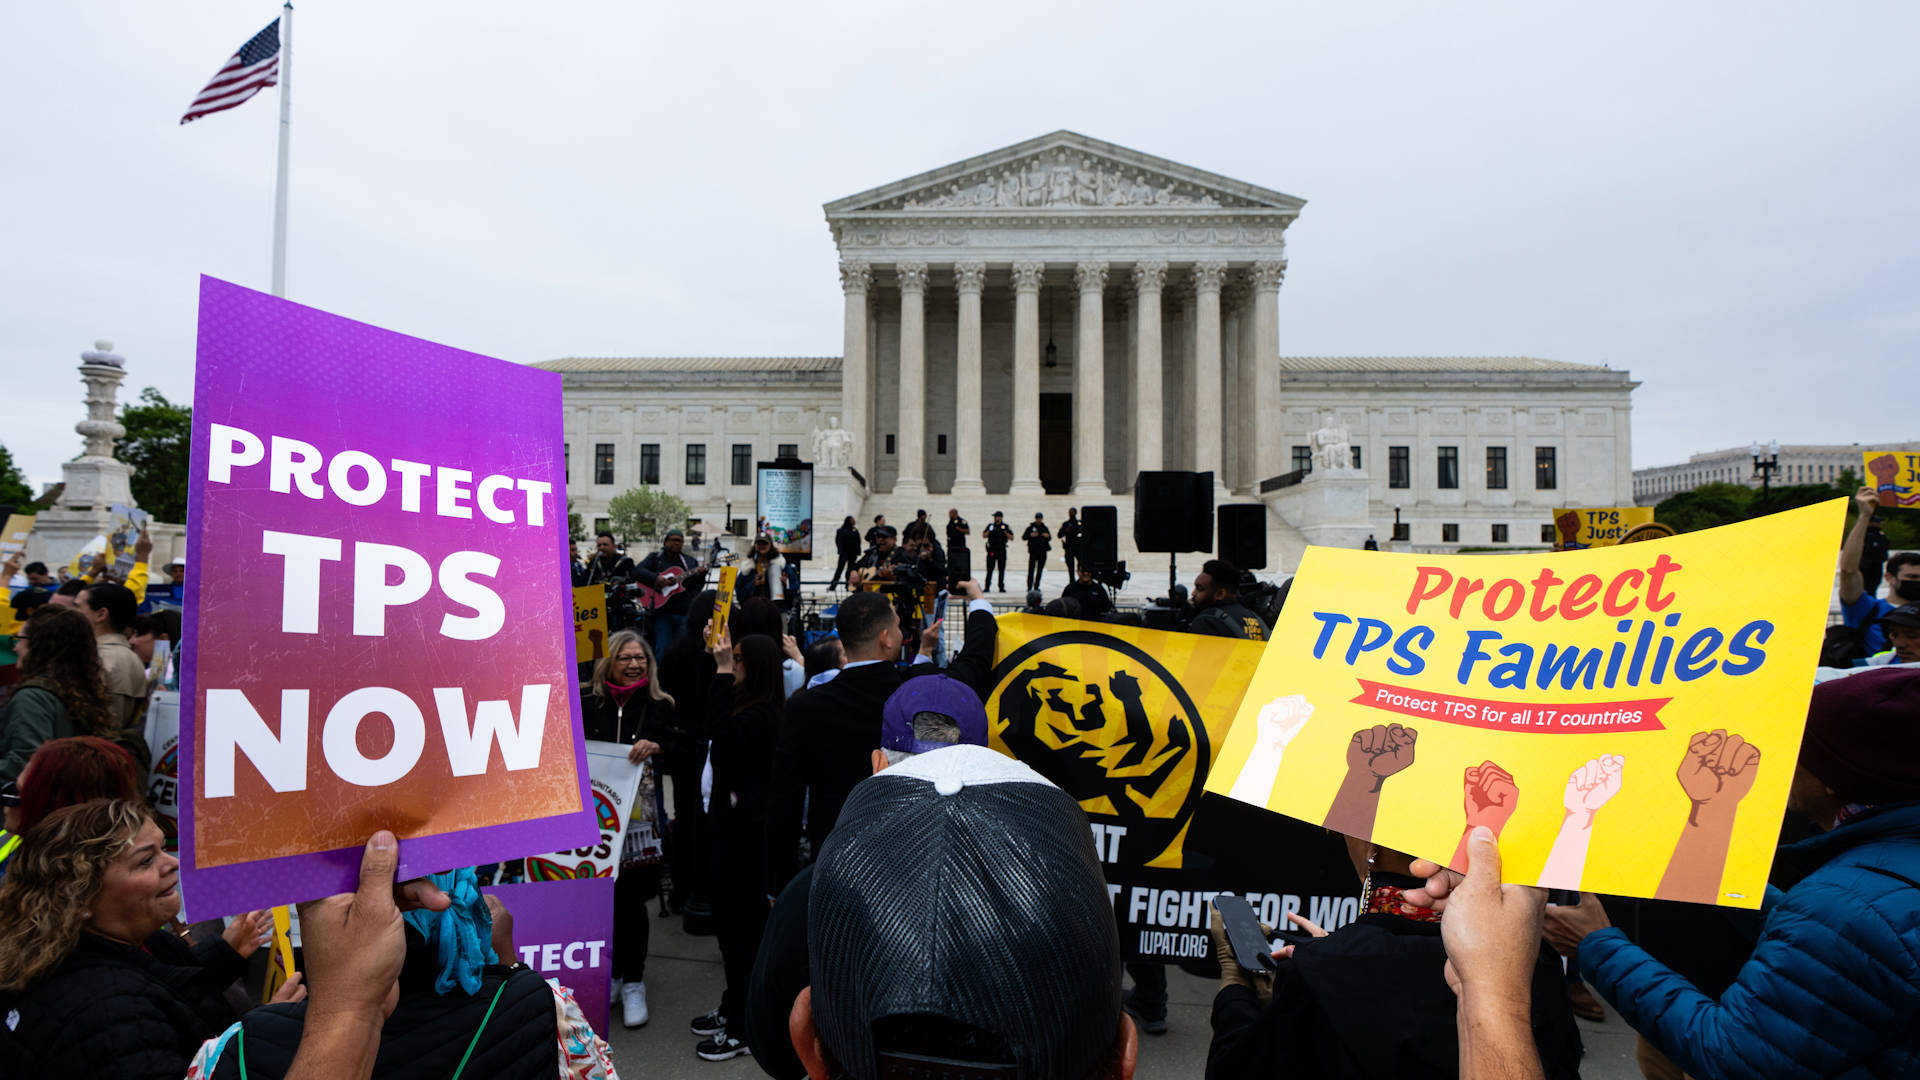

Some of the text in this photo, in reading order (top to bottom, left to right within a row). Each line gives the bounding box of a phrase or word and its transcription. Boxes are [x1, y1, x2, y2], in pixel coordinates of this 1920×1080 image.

[208, 423, 552, 527] PROTECT
[1586, 511, 1620, 525] TPS
[263, 530, 506, 641] TPS
[1406, 554, 1682, 622] Protect
[1313, 611, 1774, 691] TPS Families
[1376, 689, 1643, 726] Protect TPS for all 17 countries
[204, 683, 551, 799] NOW
[147, 778, 178, 807] CE
[1128, 886, 1236, 930] FIGHT
[1309, 896, 1361, 933] WO
[1139, 930, 1209, 958] IUPAT.ORG
